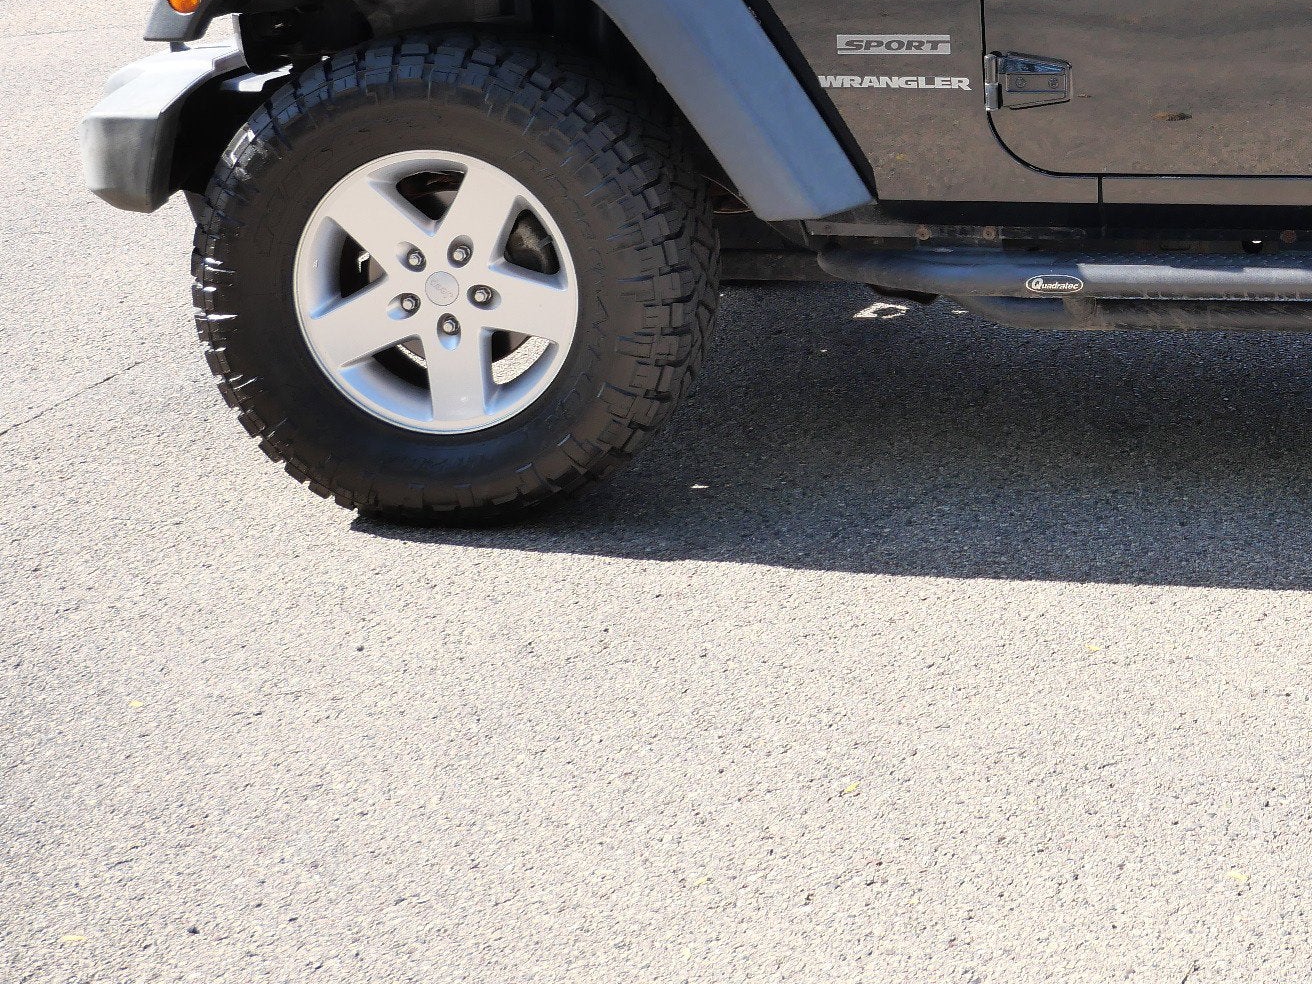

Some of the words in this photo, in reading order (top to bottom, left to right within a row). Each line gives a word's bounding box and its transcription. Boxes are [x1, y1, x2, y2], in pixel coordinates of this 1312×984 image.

[842, 38, 950, 53] SPORT
[818, 75, 972, 91] WRANGLER
[1031, 277, 1079, 290] Quadratec
